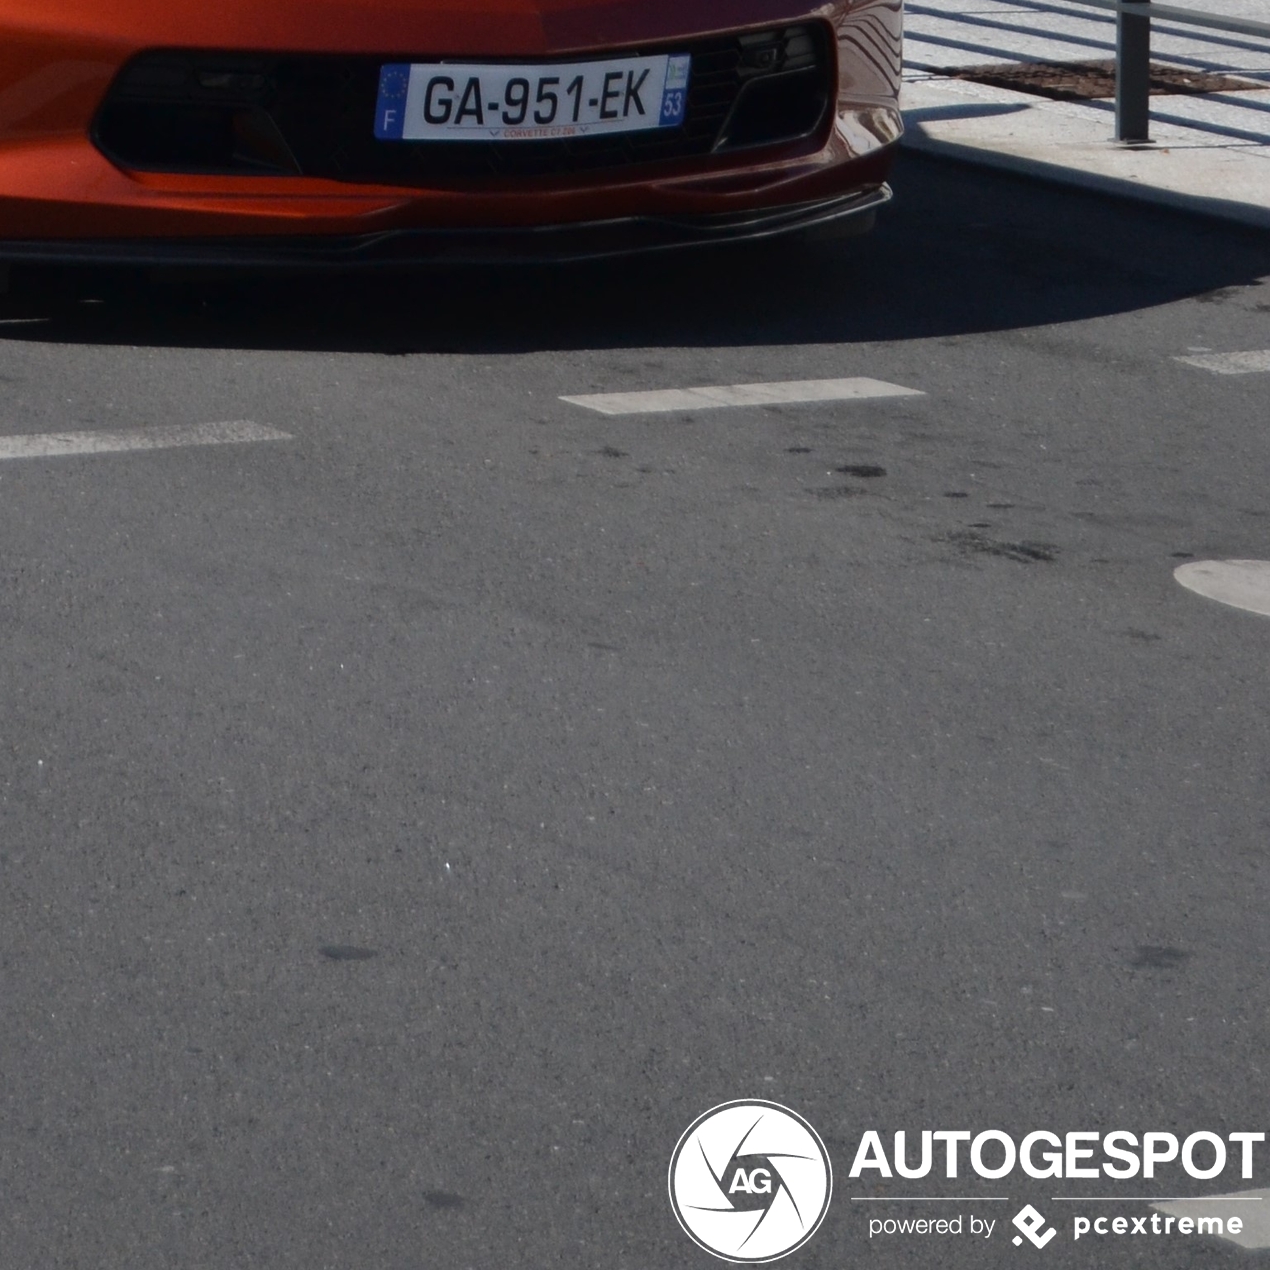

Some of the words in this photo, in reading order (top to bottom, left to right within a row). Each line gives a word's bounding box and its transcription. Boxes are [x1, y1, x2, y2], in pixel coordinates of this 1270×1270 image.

[423, 68, 650, 126] GA-951-EK
[663, 91, 682, 117] 53
[383, 109, 397, 132] F
[504, 129, 548, 138] CORVETTE
